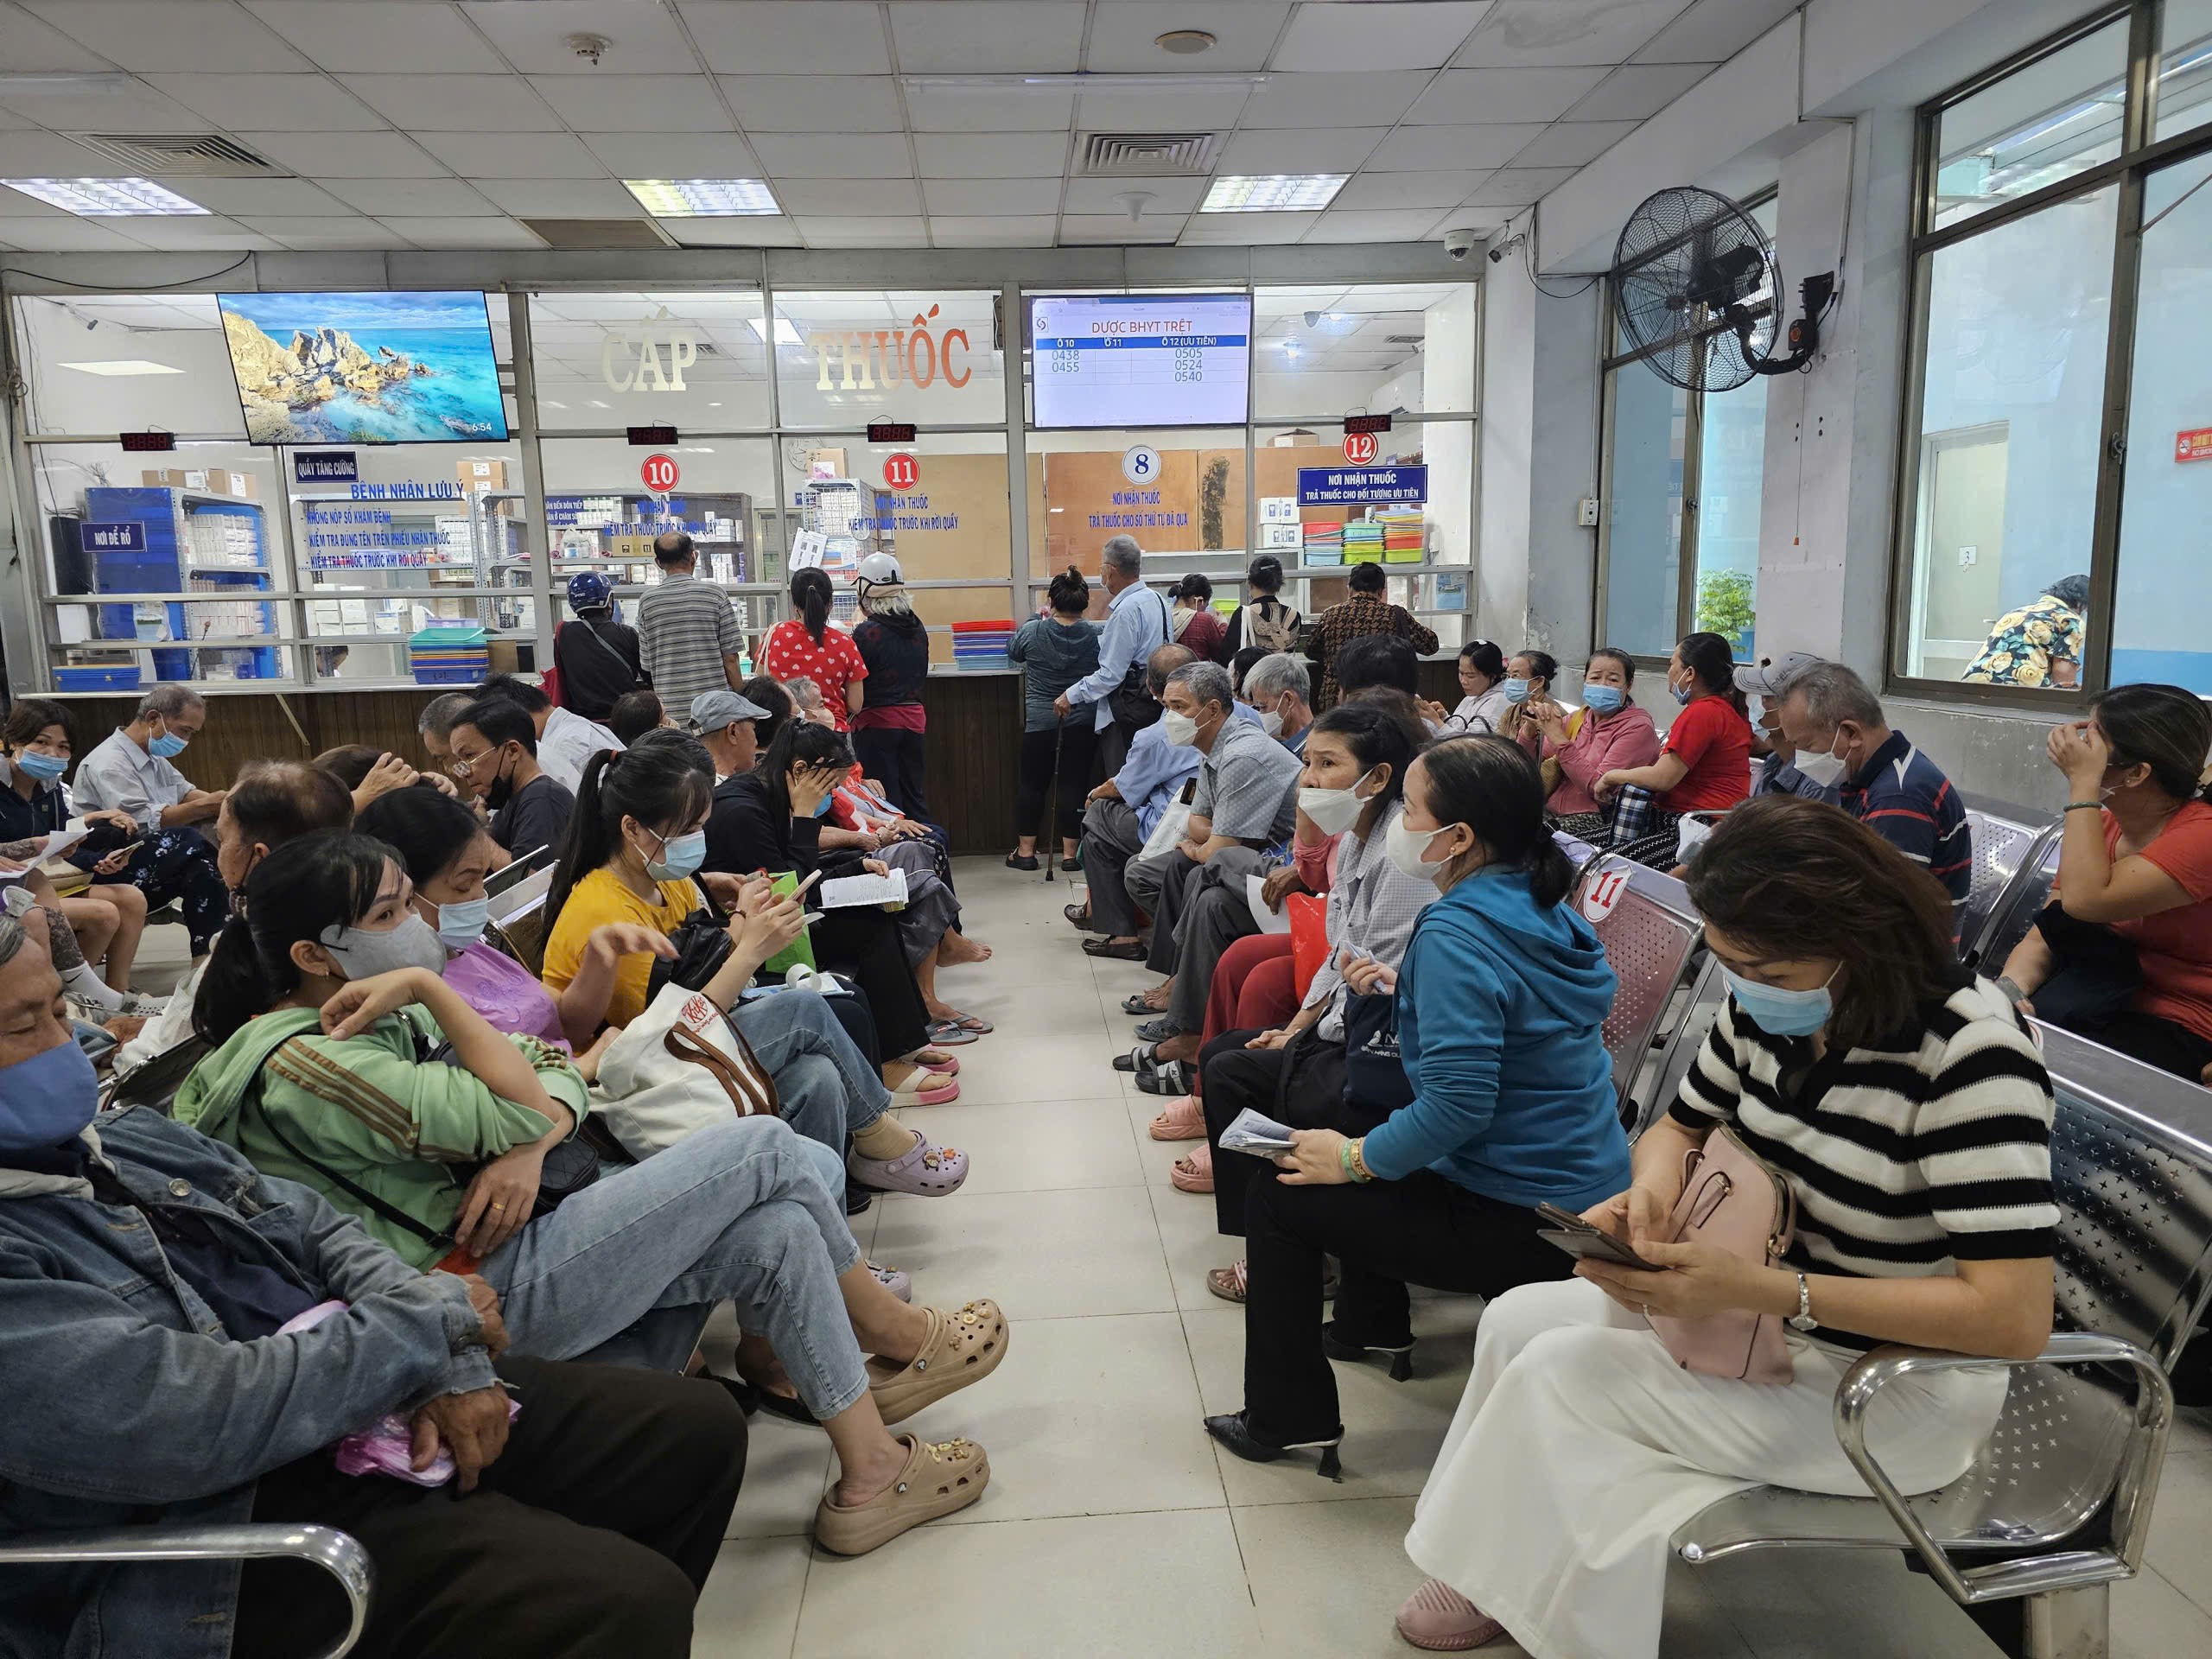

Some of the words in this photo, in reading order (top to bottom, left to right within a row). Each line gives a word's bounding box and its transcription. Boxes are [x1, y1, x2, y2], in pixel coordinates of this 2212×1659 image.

[1091, 321, 1126, 335] DƯỢC
[1129, 321, 1160, 333] BHYT
[1163, 319, 1192, 334] TRỆT
[602, 305, 697, 393] CẤP
[809, 303, 972, 391] THUỐC
[1065, 339, 1075, 347] 10
[1112, 339, 1122, 347] 11
[1170, 338, 1179, 346] 12
[1180, 337, 1196, 346] (ƯU
[1197, 336, 1217, 346] TIÊN)
[1052, 350, 1080, 361] 0438
[1175, 348, 1203, 359] 0505
[1052, 362, 1080, 372] 0455
[1175, 359, 1203, 371] 0524
[1175, 371, 1203, 382] 0540
[472, 423, 492, 431] 6:54
[1351, 436, 1372, 459] 12
[315, 460, 334, 475] TĂNG
[334, 459, 355, 475] CƯỜNG
[891, 461, 914, 483] 11
[1135, 454, 1149, 474] 8
[649, 462, 674, 485] 10
[1328, 473, 1342, 486] NƠI
[1344, 472, 1366, 486] NHẬN
[1369, 470, 1397, 484] THUỐC
[390, 480, 424, 499] NHÂN
[429, 480, 452, 498] LƯU
[456, 479, 464, 499] Ý
[1113, 490, 1122, 505] NƠI
[1124, 490, 1140, 506] NHẬN
[1141, 488, 1160, 504] THUỐC
[1306, 489, 1319, 500] TRẢ
[1319, 488, 1342, 499] THUỐC
[1343, 490, 1356, 499] CHO
[1357, 487, 1369, 499] ĐỐI
[1370, 488, 1392, 499] TƯỢNG
[1393, 488, 1402, 498] ƯU
[1403, 486, 1419, 498] TIÊN
[889, 493, 906, 512] NHẬN
[908, 493, 928, 509] THUỐC
[307, 508, 328, 524] KHÔNG
[330, 508, 342, 527] NỘP
[344, 505, 352, 524] SỔ
[353, 508, 372, 524] KHÁM
[849, 512, 863, 530] KIỂM
[865, 518, 876, 530] TRA
[899, 514, 918, 530] TRƯỚC
[920, 517, 930, 530] KHI
[931, 512, 942, 530] RỜI
[1089, 512, 1100, 528] TRẢ
[1103, 512, 1121, 527] THUỐC
[1122, 515, 1134, 527] CHO
[1135, 510, 1142, 526] SỐ
[1176, 512, 1188, 527] QUA
[94, 531, 107, 545] NƠI
[109, 526, 118, 544] ĐỂ
[121, 525, 130, 544] RỔ
[309, 528, 326, 547] KIỂM
[326, 534, 340, 547] TRA
[340, 530, 358, 546] ĐÚNG
[359, 531, 371, 546] TÊN
[372, 530, 390, 546] TRÊN
[391, 528, 410, 545] PHIẾU
[411, 530, 429, 547] NHẬN
[429, 528, 450, 545] THUỐC
[621, 523, 632, 536] TRA
[311, 550, 327, 569] KIỂM
[327, 556, 341, 569] TRA
[341, 551, 363, 568] THUỐC
[364, 551, 385, 567] TRƯỚC
[386, 554, 397, 567] KHI
[1590, 871, 1624, 909] 11
